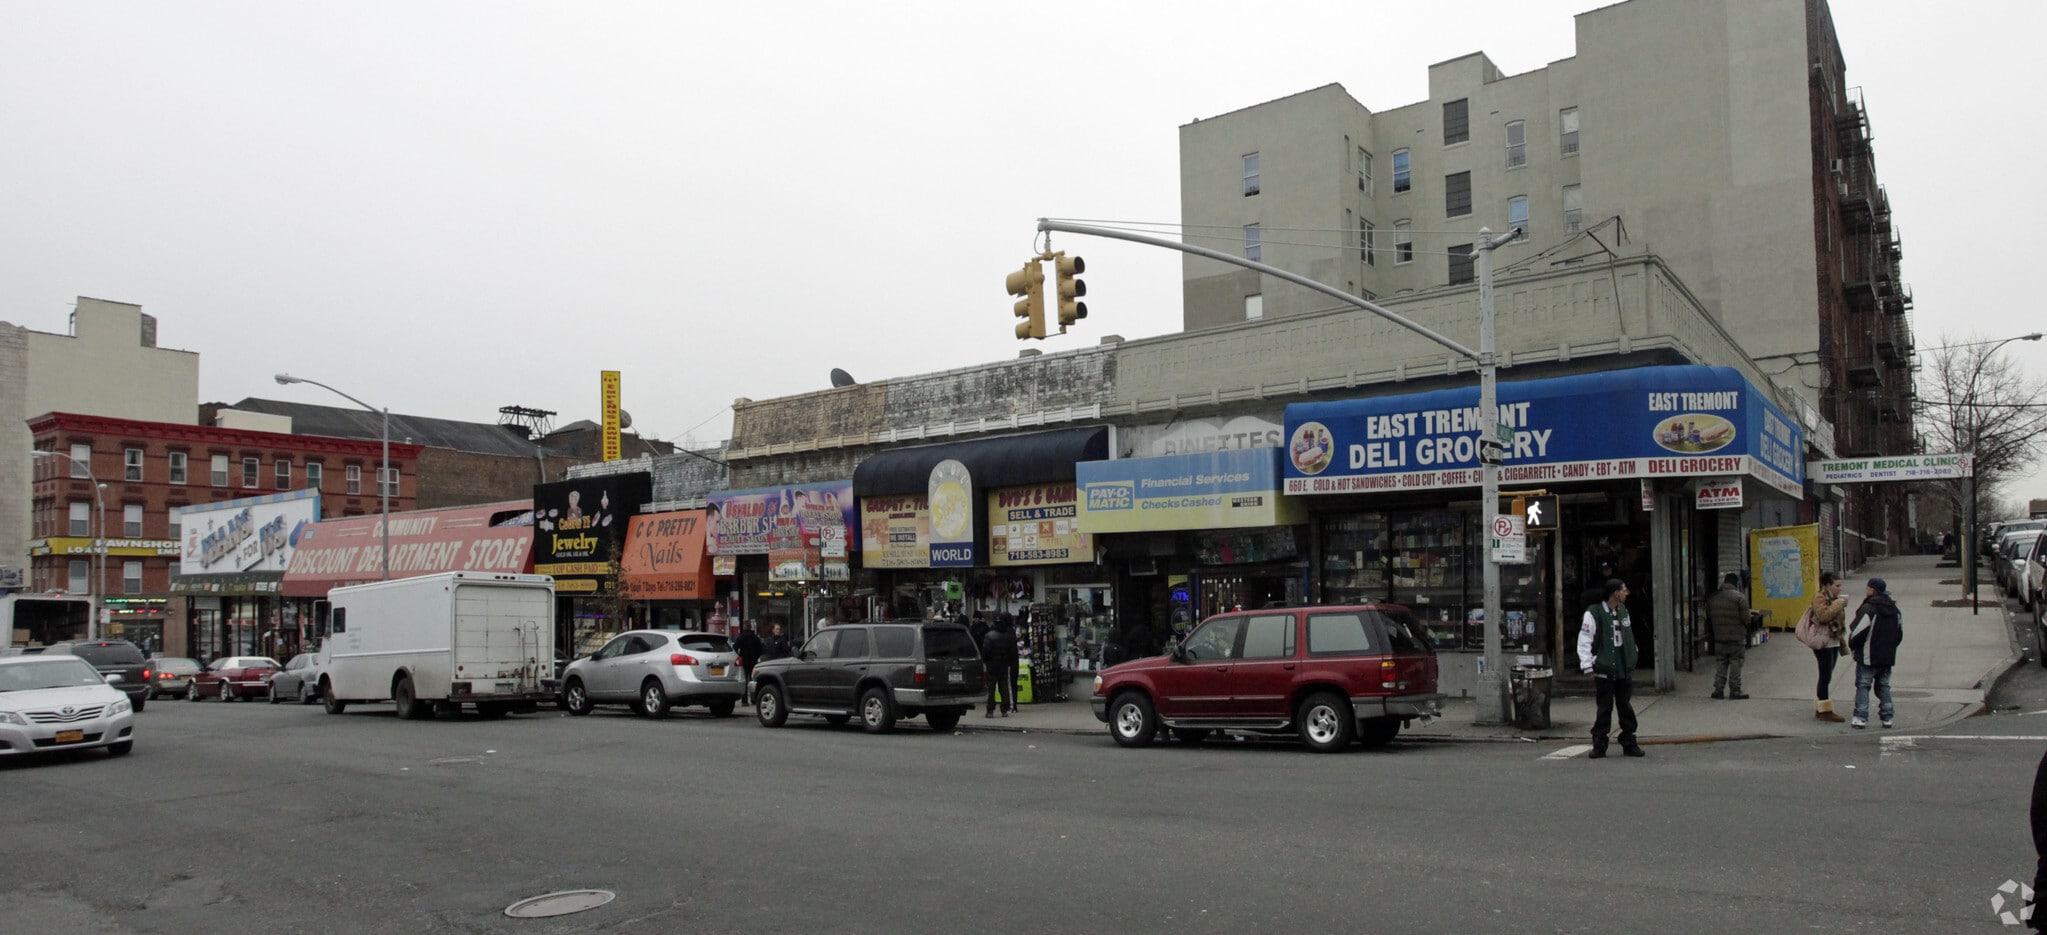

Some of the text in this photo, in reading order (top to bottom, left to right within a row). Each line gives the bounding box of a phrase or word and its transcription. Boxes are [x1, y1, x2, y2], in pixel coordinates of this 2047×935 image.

[1649, 391, 1738, 411] EAST TREMONT
[1367, 411, 1418, 440] EAST
[1422, 402, 1531, 434] TREMNT
[1349, 441, 1407, 470] DELI
[1822, 456, 1958, 473] TREMONT MEDICAL CLINIC
[1141, 472, 1250, 489] Financial Services
[1289, 480, 1302, 492] 660
[1313, 478, 1330, 491] COLD
[1331, 480, 1336, 490] &
[1338, 477, 1350, 490] HOT
[1352, 474, 1398, 490] SANDWICHES
[1402, 473, 1420, 487] COLD
[1422, 472, 1436, 486] CUT
[1441, 470, 1467, 485] COFFEE
[1497, 470, 1503, 481] &
[1505, 464, 1557, 482] CIGGARRETTE
[1562, 462, 1590, 476] CANDY
[1596, 461, 1612, 476] EBT
[1618, 460, 1636, 475] ATM
[1648, 460, 1677, 474] DELI
[1680, 457, 1742, 473] GROCERY
[1825, 472, 1863, 480] PEDIATRICS
[1870, 470, 1897, 478] DENTIST
[1698, 486, 1740, 499] ATM
[1089, 497, 1131, 508] MATIC
[1141, 496, 1222, 510] Checks Cashed
[1010, 506, 1075, 520] SELL & TRADE
[636, 517, 697, 538] C C PRETTY
[720, 517, 760, 535] BARBER
[243, 540, 259, 561] FOR
[552, 533, 598, 555] Jewelry
[289, 536, 528, 575] DISCOUNT DEPARTMENT STORE
[641, 541, 684, 571] Nails
[932, 548, 972, 562] WORLD
[566, 565, 582, 573] CASH
[584, 564, 598, 572] PAID
